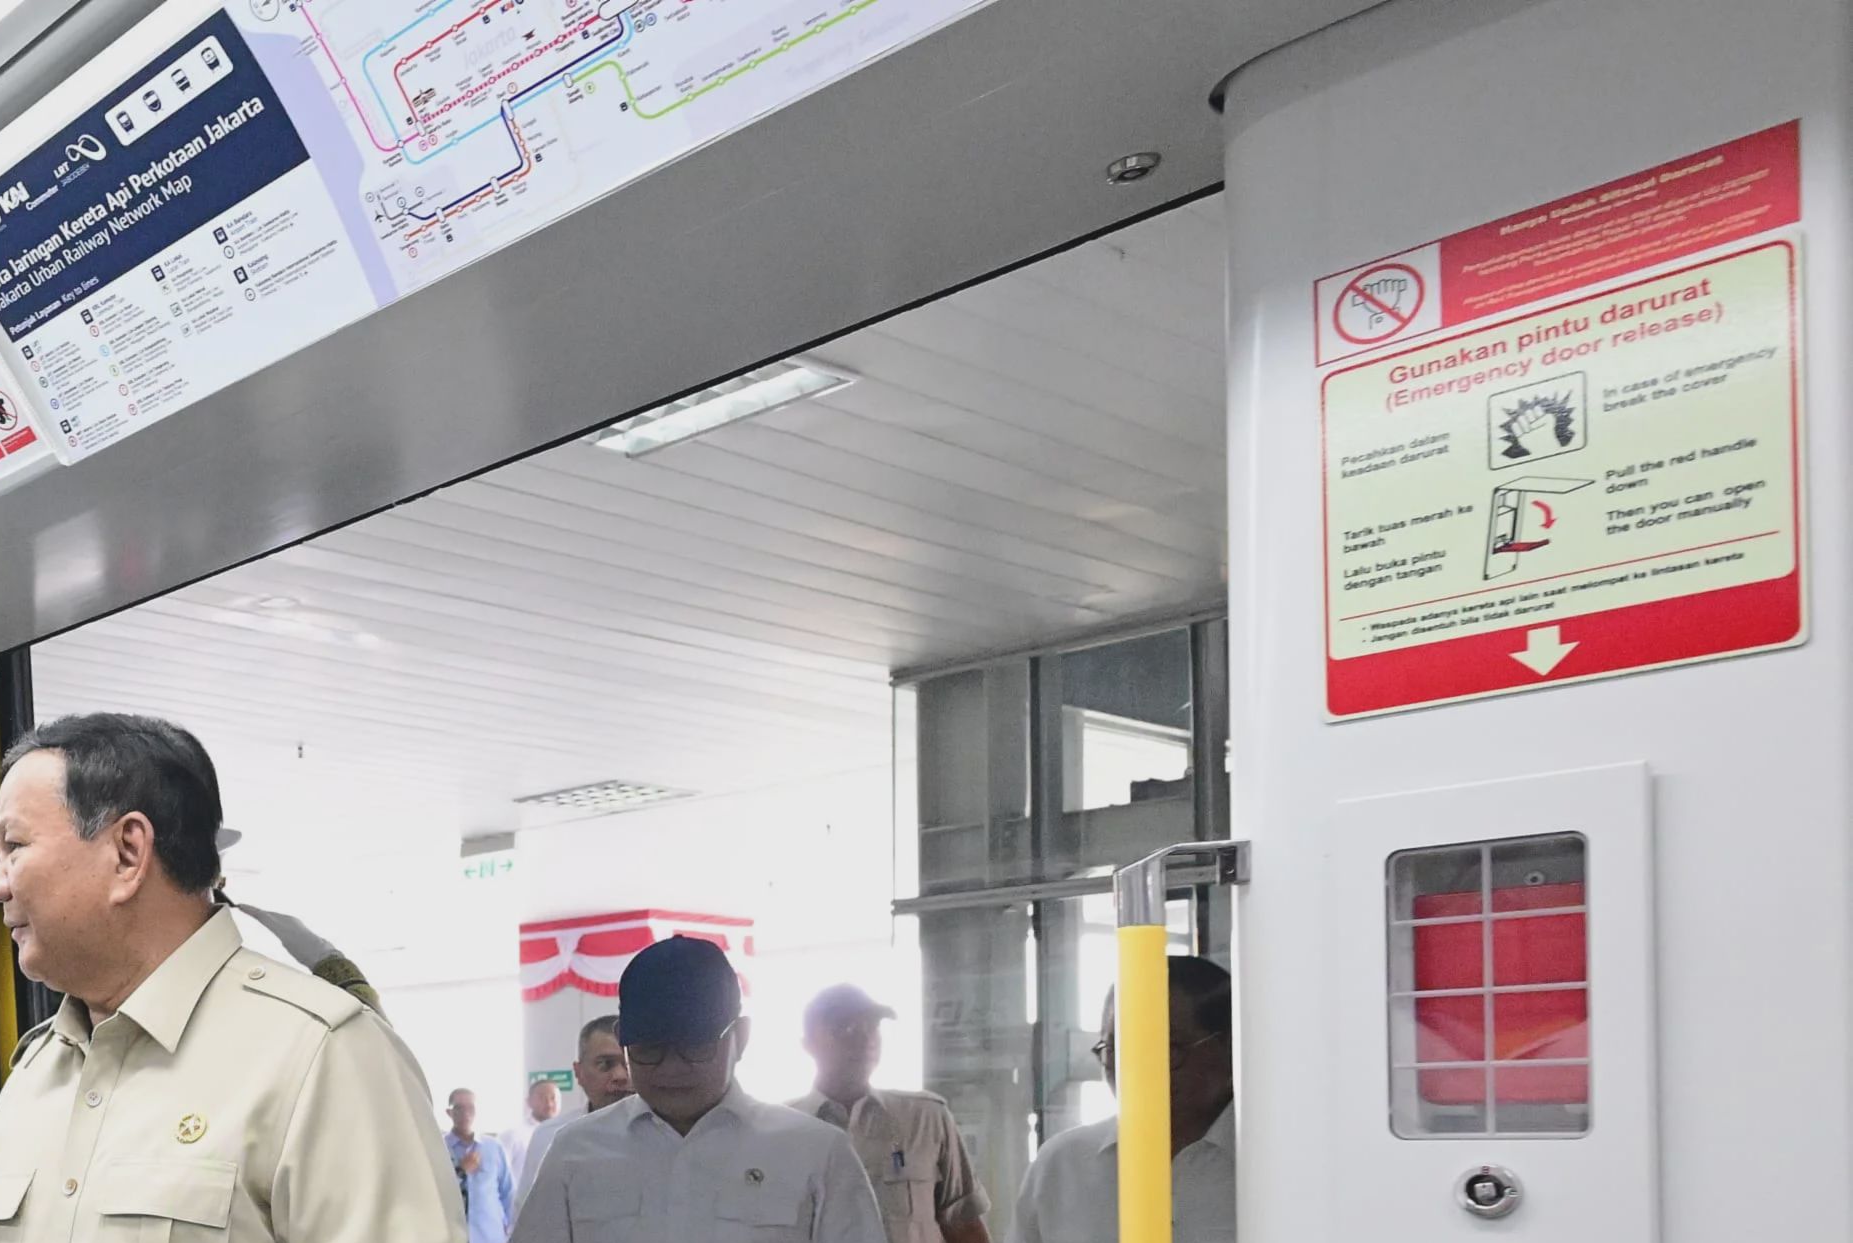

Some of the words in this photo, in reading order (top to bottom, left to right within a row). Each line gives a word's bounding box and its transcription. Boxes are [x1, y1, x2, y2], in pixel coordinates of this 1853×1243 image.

[8, 234, 63, 275] Jaringan
[59, 204, 107, 240] Kereta
[105, 182, 132, 210] Api
[128, 136, 205, 192] Perkotaan
[204, 97, 263, 143] Jakarta
[53, 161, 69, 178] LRT
[28, 259, 65, 286] Urban
[62, 228, 110, 264] Railway
[108, 193, 162, 234] Network
[160, 175, 191, 200] Map
[9, 314, 36, 334] Petunjuk
[61, 291, 75, 302] Key
[73, 286, 82, 295] to
[80, 276, 98, 290] lines
[1389, 341, 1506, 383] Gunakan
[1518, 317, 1588, 351] pintu
[1600, 279, 1709, 323] darurat
[1386, 358, 1531, 409] (Emergency
[1541, 338, 1602, 365] door
[1612, 302, 1722, 346] release)
[1602, 388, 1617, 398] In
[1621, 378, 1658, 393] case
[1663, 369, 1680, 382] of
[1603, 394, 1646, 412] break
[1652, 387, 1676, 399] the
[1682, 374, 1727, 391] cover
[1341, 444, 1404, 465] Pecahkan
[1409, 432, 1449, 448] dalam
[1341, 459, 1395, 478] keadaan
[1399, 444, 1448, 463] darurat
[1605, 465, 1634, 479] Pull
[1640, 460, 1664, 472] the
[1669, 451, 1695, 464] red
[1701, 439, 1756, 457] handle
[1605, 478, 1647, 493] down
[1606, 506, 1644, 520] Then
[1649, 499, 1679, 514] you
[1684, 491, 1713, 503] can
[1723, 480, 1765, 495] open
[1343, 527, 1373, 539] Tarik
[1378, 520, 1406, 532] tuas
[1410, 509, 1452, 524] merah
[1457, 505, 1473, 514] ke
[1606, 523, 1630, 534] the
[1635, 514, 1671, 528] door
[1677, 497, 1751, 519] manually
[1343, 537, 1384, 553] bawah
[1343, 566, 1371, 578] Lalu
[1375, 558, 1407, 571] buka
[1411, 550, 1445, 565] pintu
[1344, 574, 1392, 590] dengan
[1396, 564, 1442, 579] tangan
[1498, 597, 1515, 605] api
